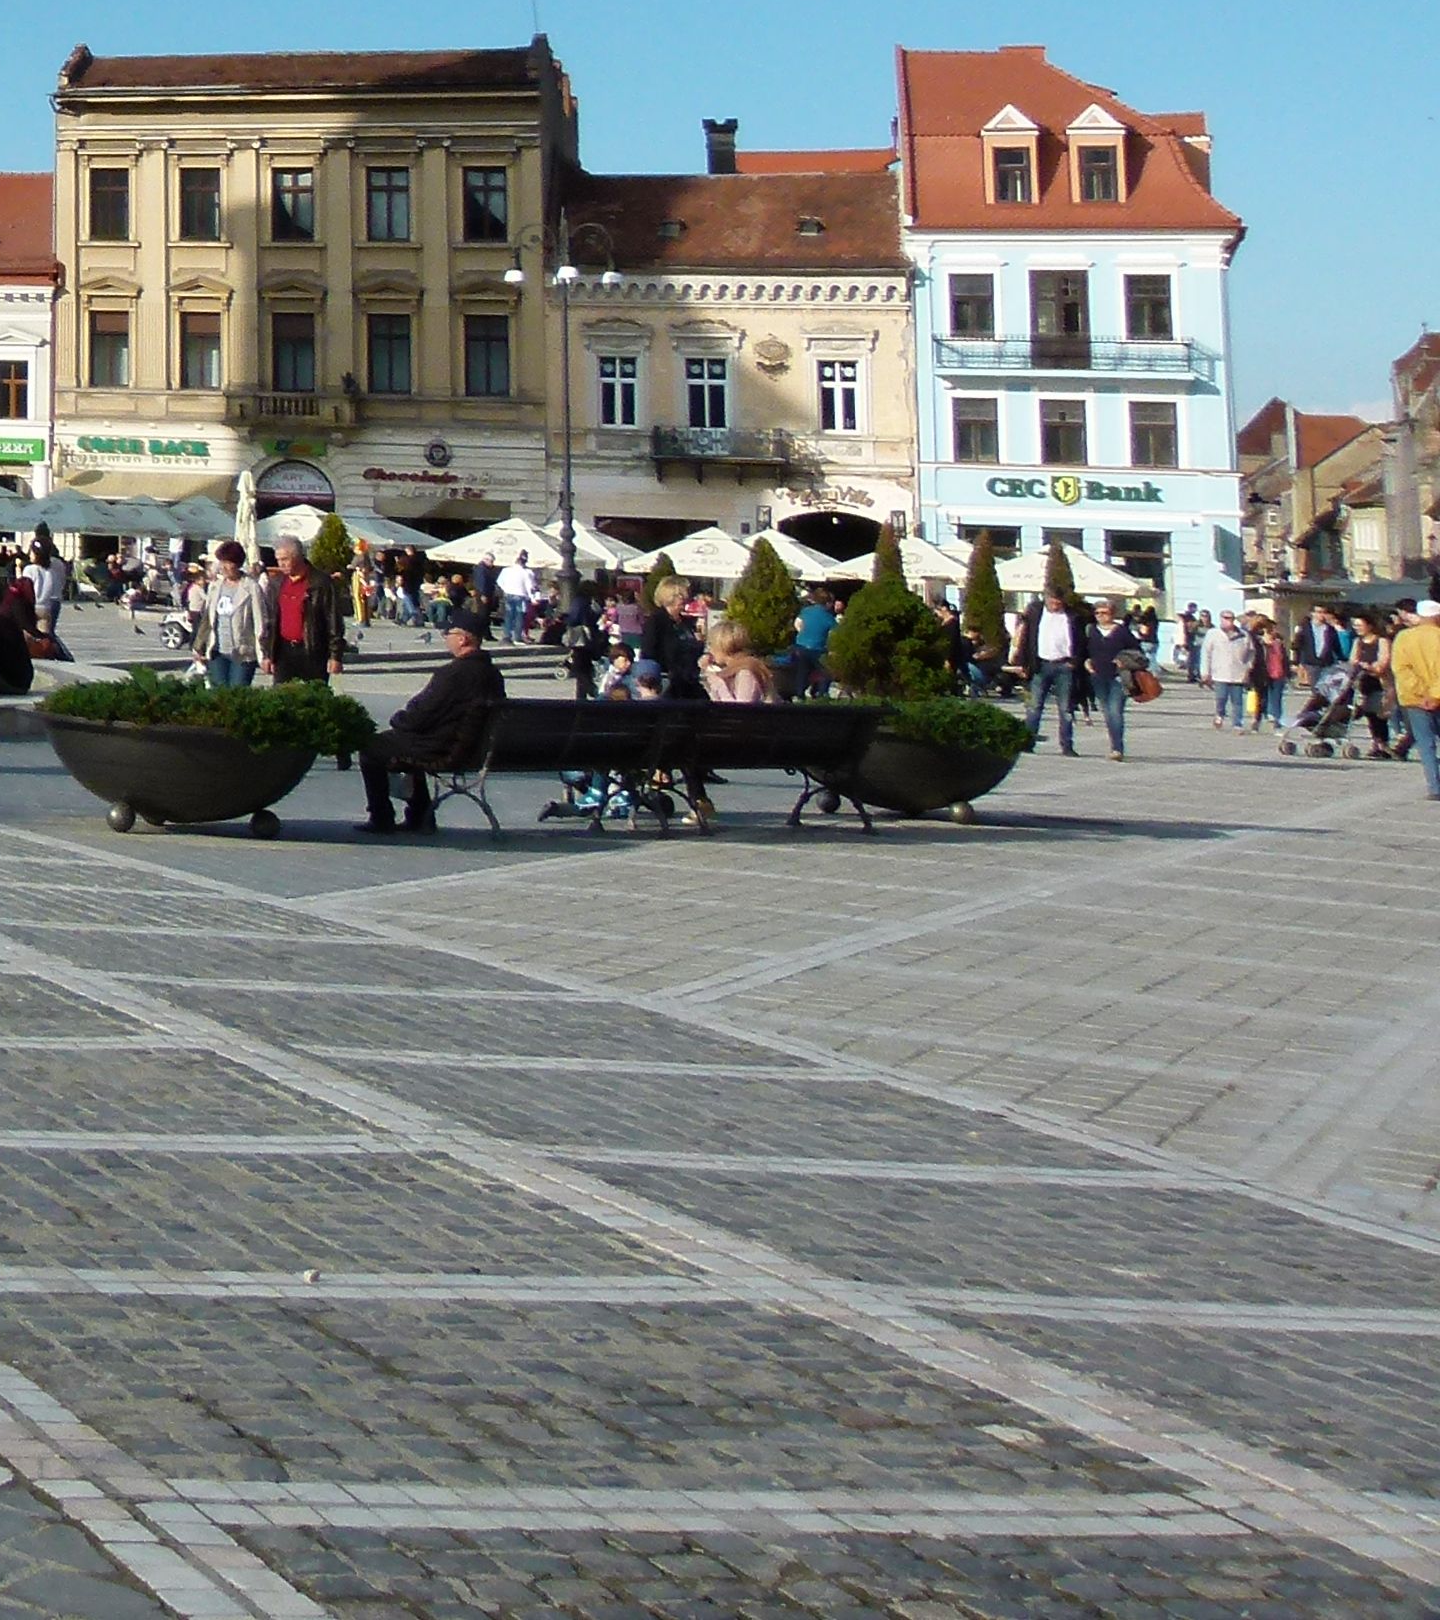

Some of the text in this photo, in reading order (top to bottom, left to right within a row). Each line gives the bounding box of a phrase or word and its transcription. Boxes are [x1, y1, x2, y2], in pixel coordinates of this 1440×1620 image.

[152, 454, 209, 467] bakery
[986, 477, 1164, 503] CEC Bank
